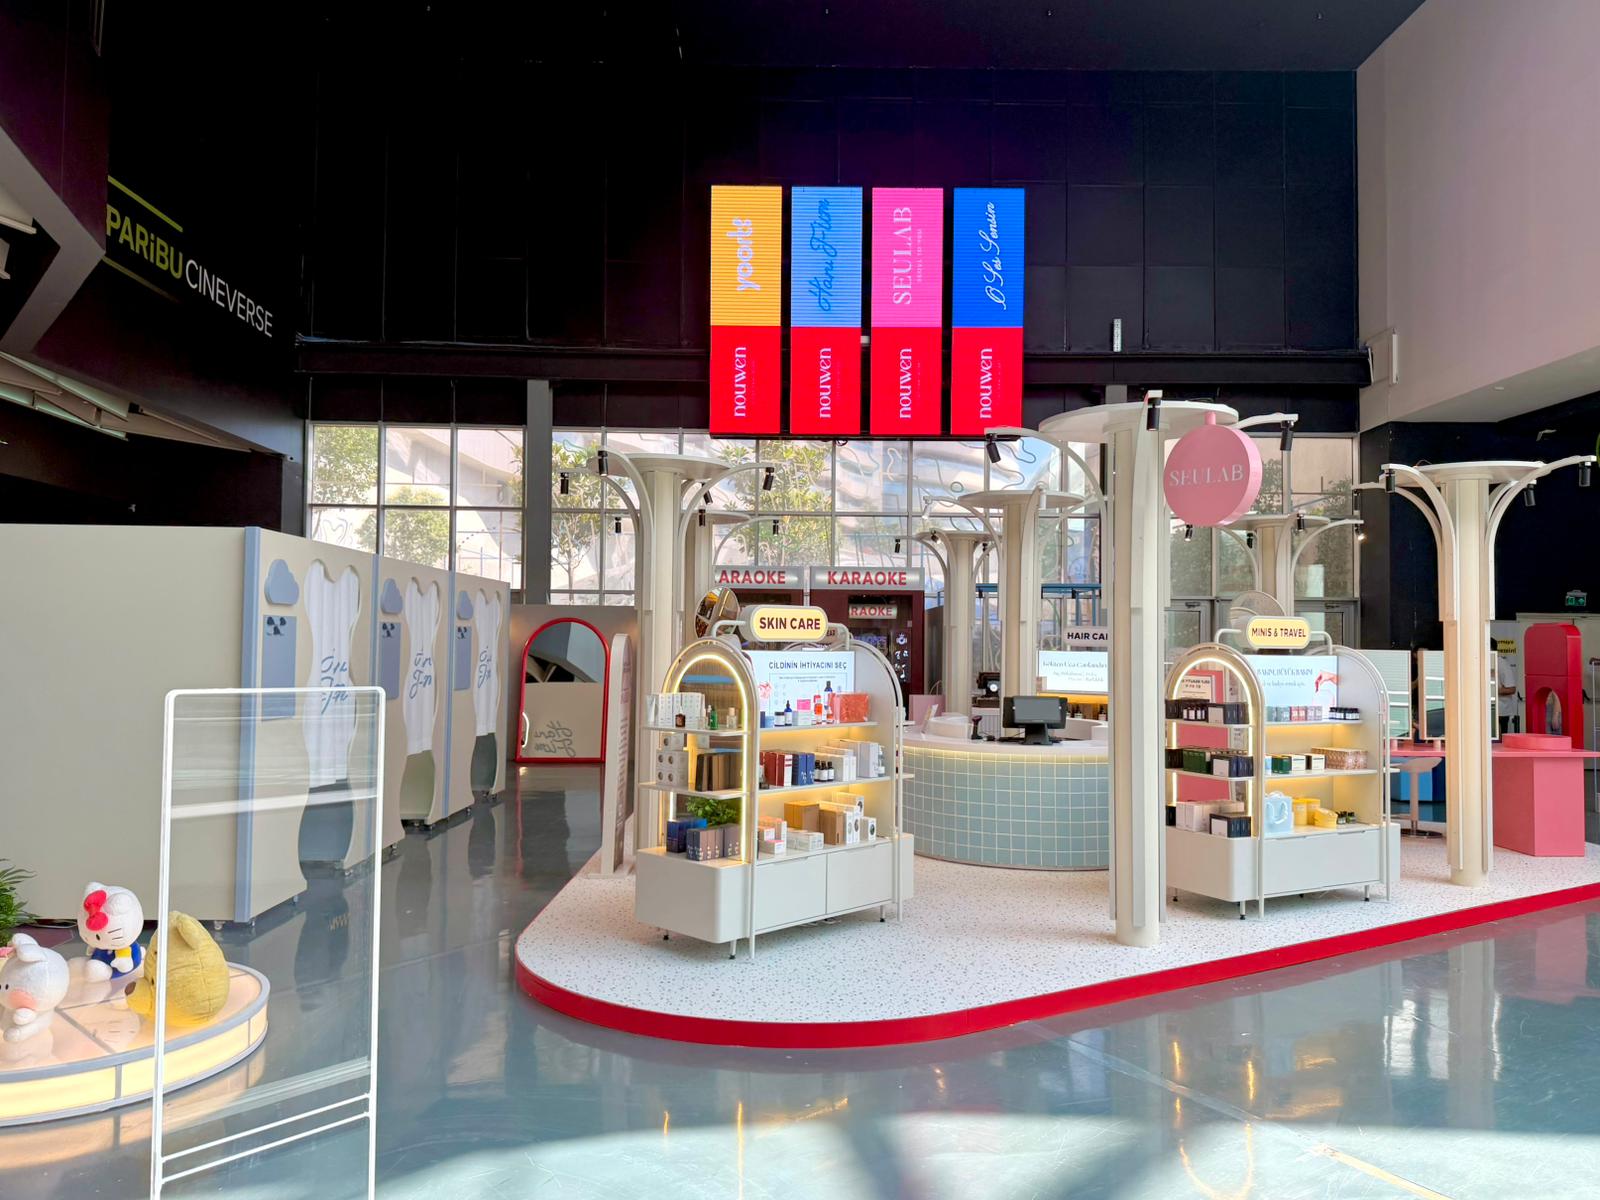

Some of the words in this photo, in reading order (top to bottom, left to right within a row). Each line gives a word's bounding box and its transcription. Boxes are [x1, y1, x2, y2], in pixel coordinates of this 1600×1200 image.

[979, 201, 1001, 256] Sensin
[892, 206, 912, 305] SEULAB
[982, 256, 1005, 287] Ses
[185, 259, 273, 337] CINEVERSE
[734, 347, 746, 417] nouwen
[819, 348, 831, 418] nouwen
[900, 348, 912, 418] nouwen
[980, 348, 992, 418] nouwen
[1170, 464, 1244, 487] SEULAB
[716, 570, 786, 585] ARAOKE
[827, 571, 907, 585] KARAOKE
[759, 617, 787, 630] SKIN
[790, 618, 821, 630] CARE
[1067, 632, 1091, 640] HAIR
[1252, 628, 1272, 637] MINIS
[1273, 628, 1278, 637] &
[1280, 628, 1306, 638] TRAVEL
